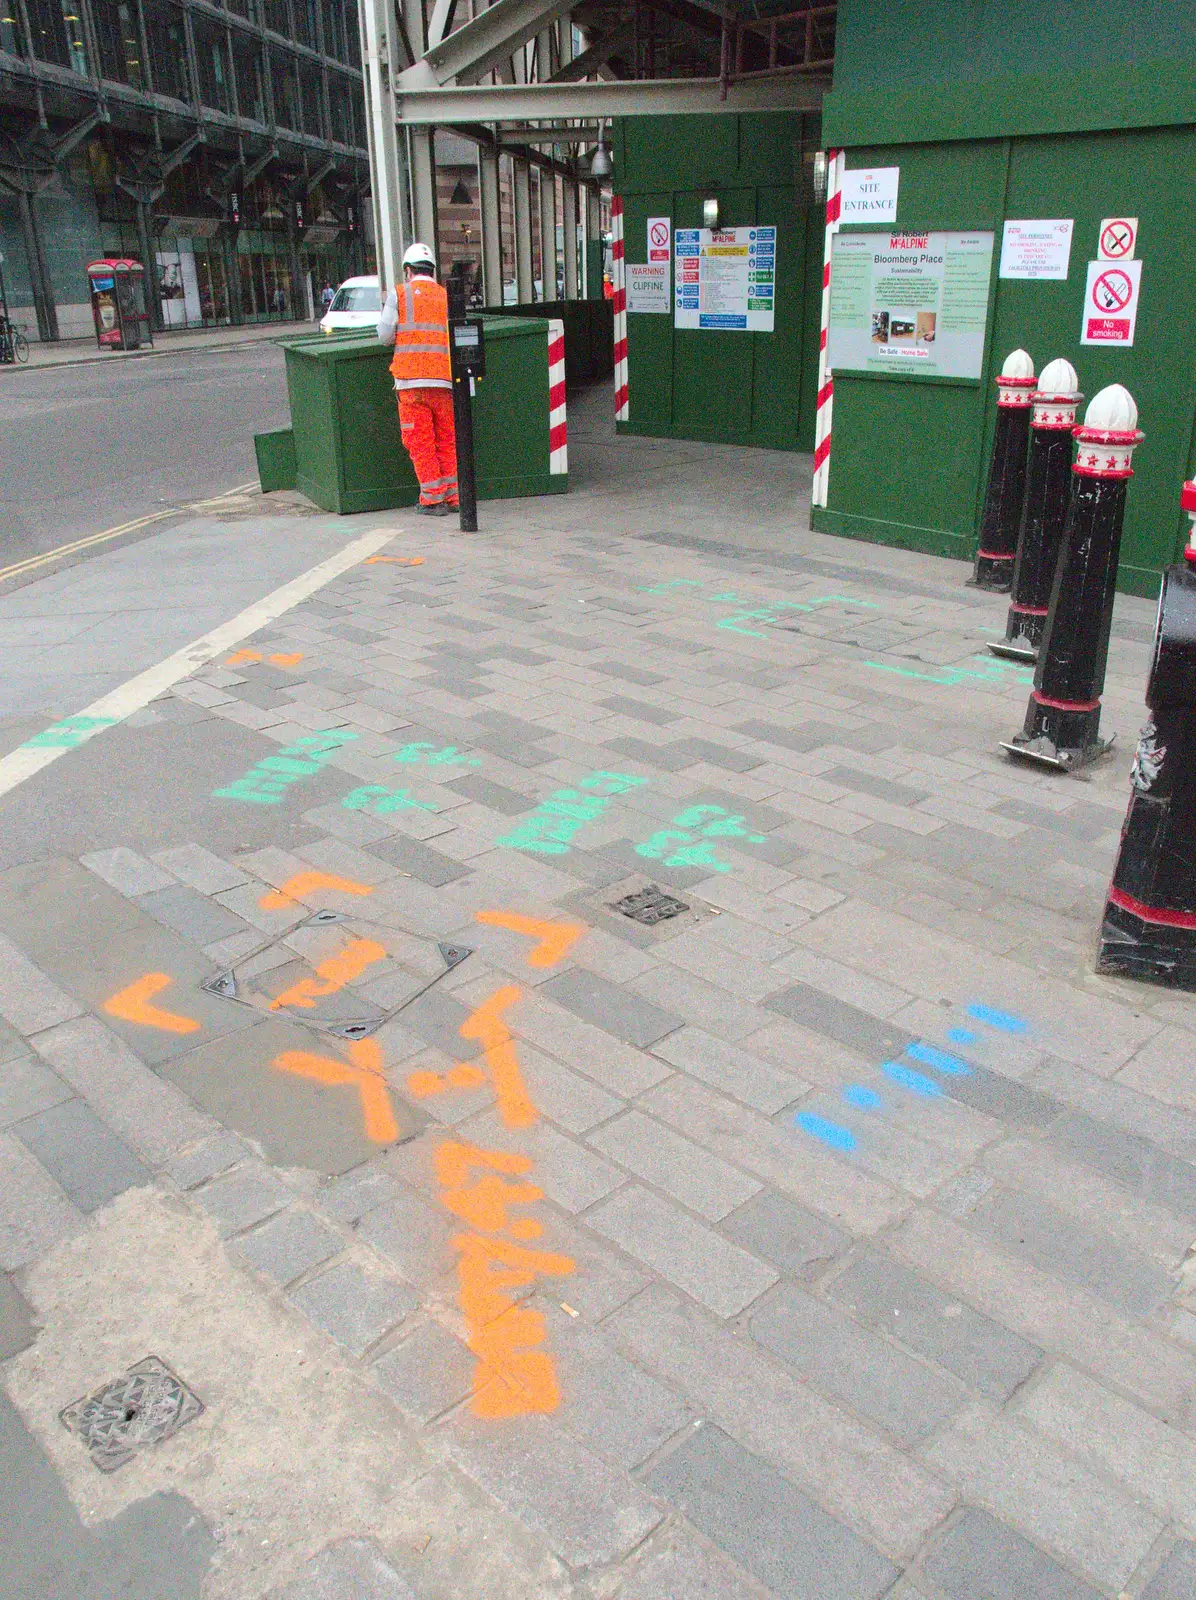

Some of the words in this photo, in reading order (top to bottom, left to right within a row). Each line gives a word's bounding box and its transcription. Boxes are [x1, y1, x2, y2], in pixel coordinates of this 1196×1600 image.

[860, 183, 880, 193] SITE
[231, 193, 239, 212] HSBC
[844, 199, 894, 211] ENTRANCE
[295, 202, 303, 219] HSBC
[874, 254, 918, 265] Bloomberg
[920, 254, 943, 265] Place
[632, 267, 665, 276] WARNING
[891, 267, 923, 275] Sustainability
[633, 281, 664, 290] CLIPFINE
[1103, 319, 1114, 328] No
[1092, 329, 1123, 339] smoking
